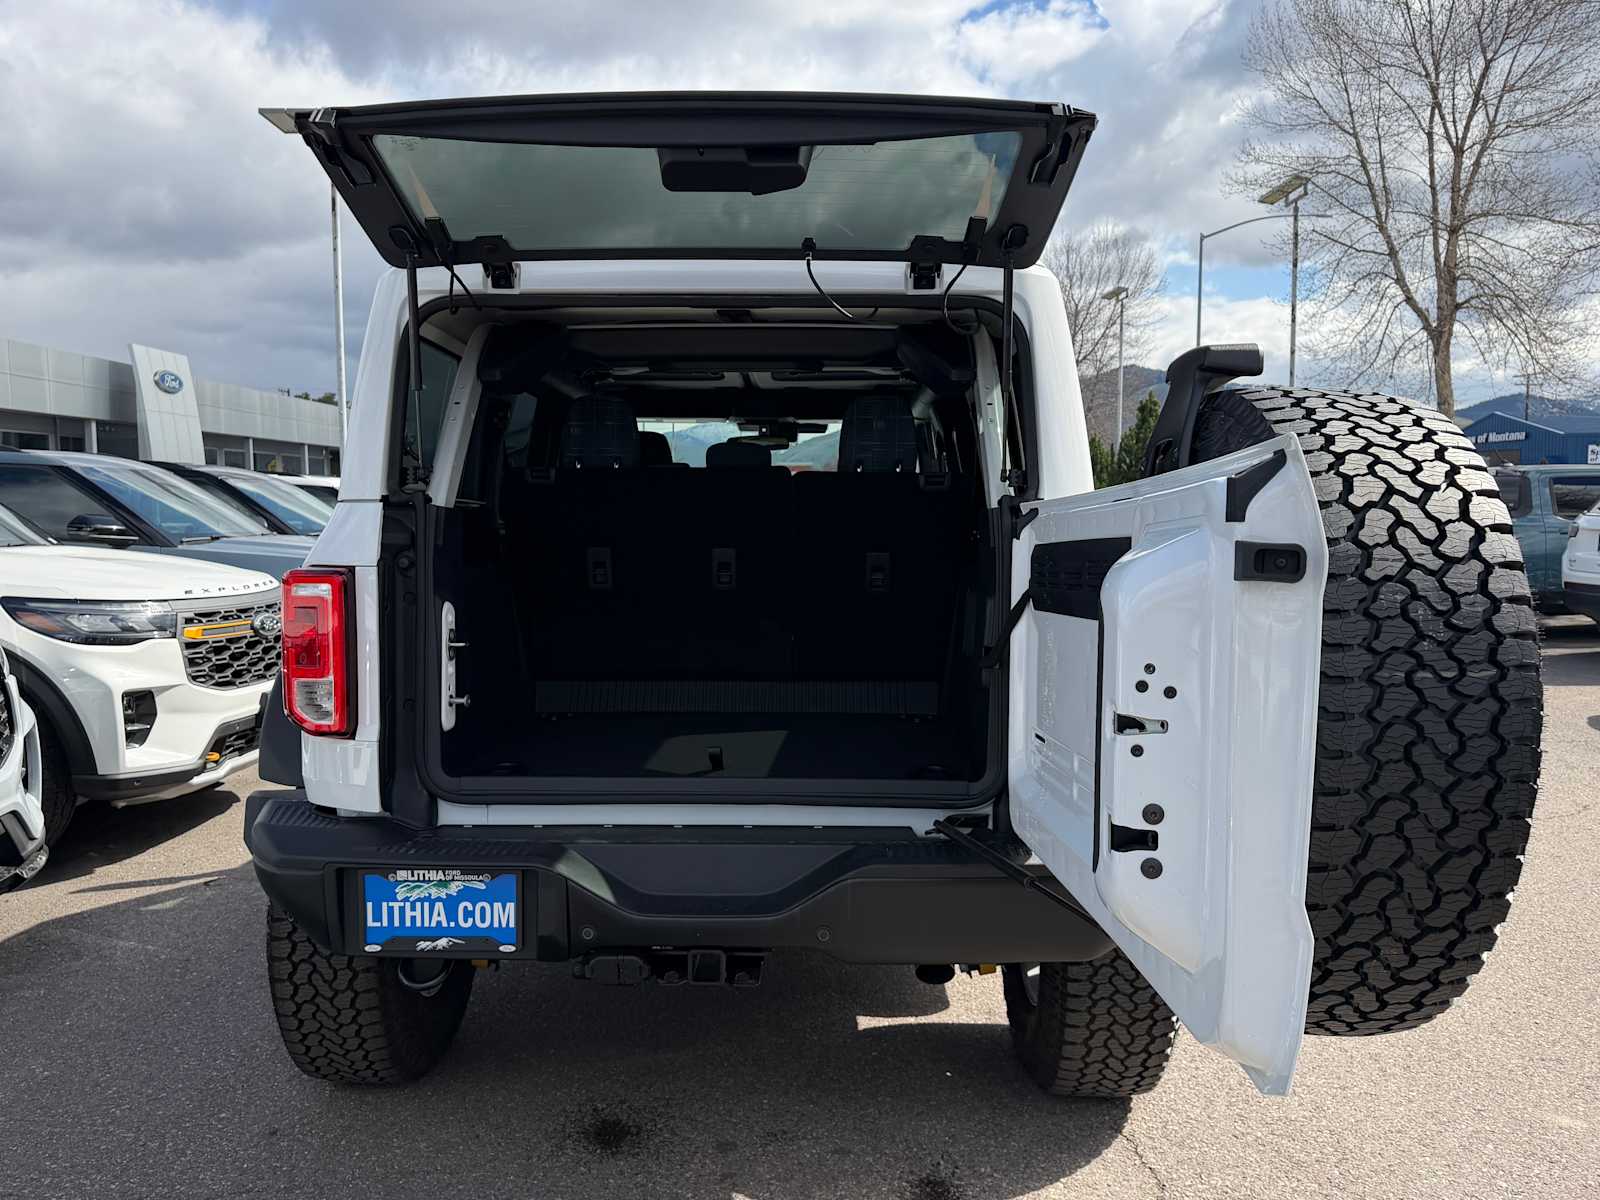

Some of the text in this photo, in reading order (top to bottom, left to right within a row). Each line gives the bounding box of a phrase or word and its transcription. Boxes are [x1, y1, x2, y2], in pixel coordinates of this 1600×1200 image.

[1477, 432, 1488, 443] of
[1488, 431, 1526, 443] Montana
[184, 580, 274, 595] EXPLORER
[407, 870, 446, 881] LITHIA
[366, 901, 515, 928] LITHIA.COM
